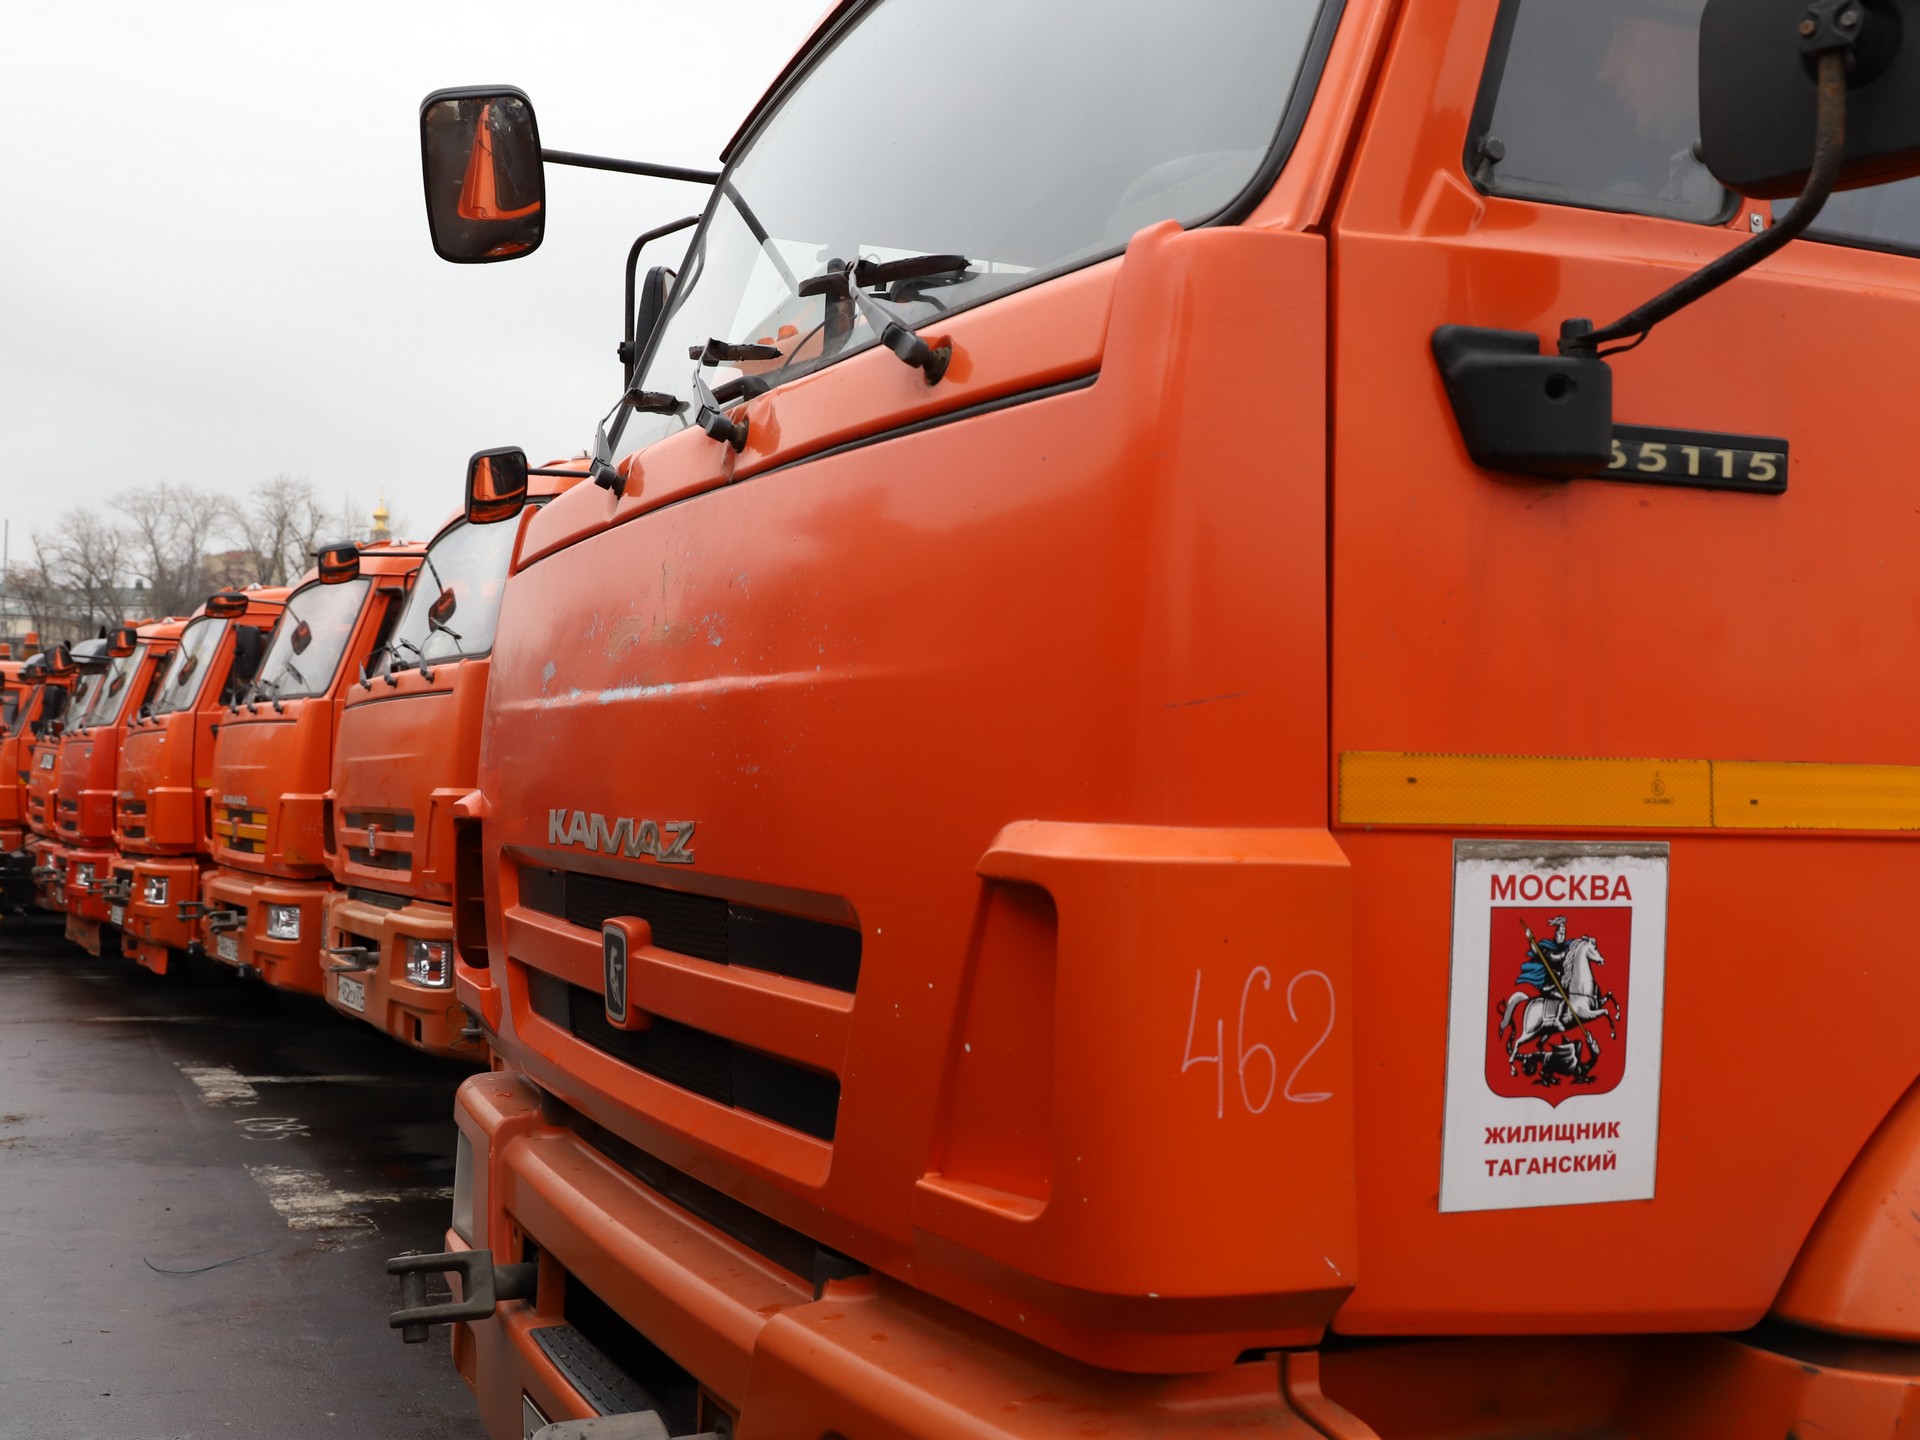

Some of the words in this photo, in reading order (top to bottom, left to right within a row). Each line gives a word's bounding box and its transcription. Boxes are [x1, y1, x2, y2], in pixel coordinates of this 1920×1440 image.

[548, 808, 695, 864] KAMAZ
[1490, 874, 1633, 901] МОСКВА
[1180, 965, 1336, 1120] 462
[1484, 1121, 1621, 1145] ЖИЛИЩНИК
[1485, 1150, 1617, 1177] ТАГАНСКИЙ
